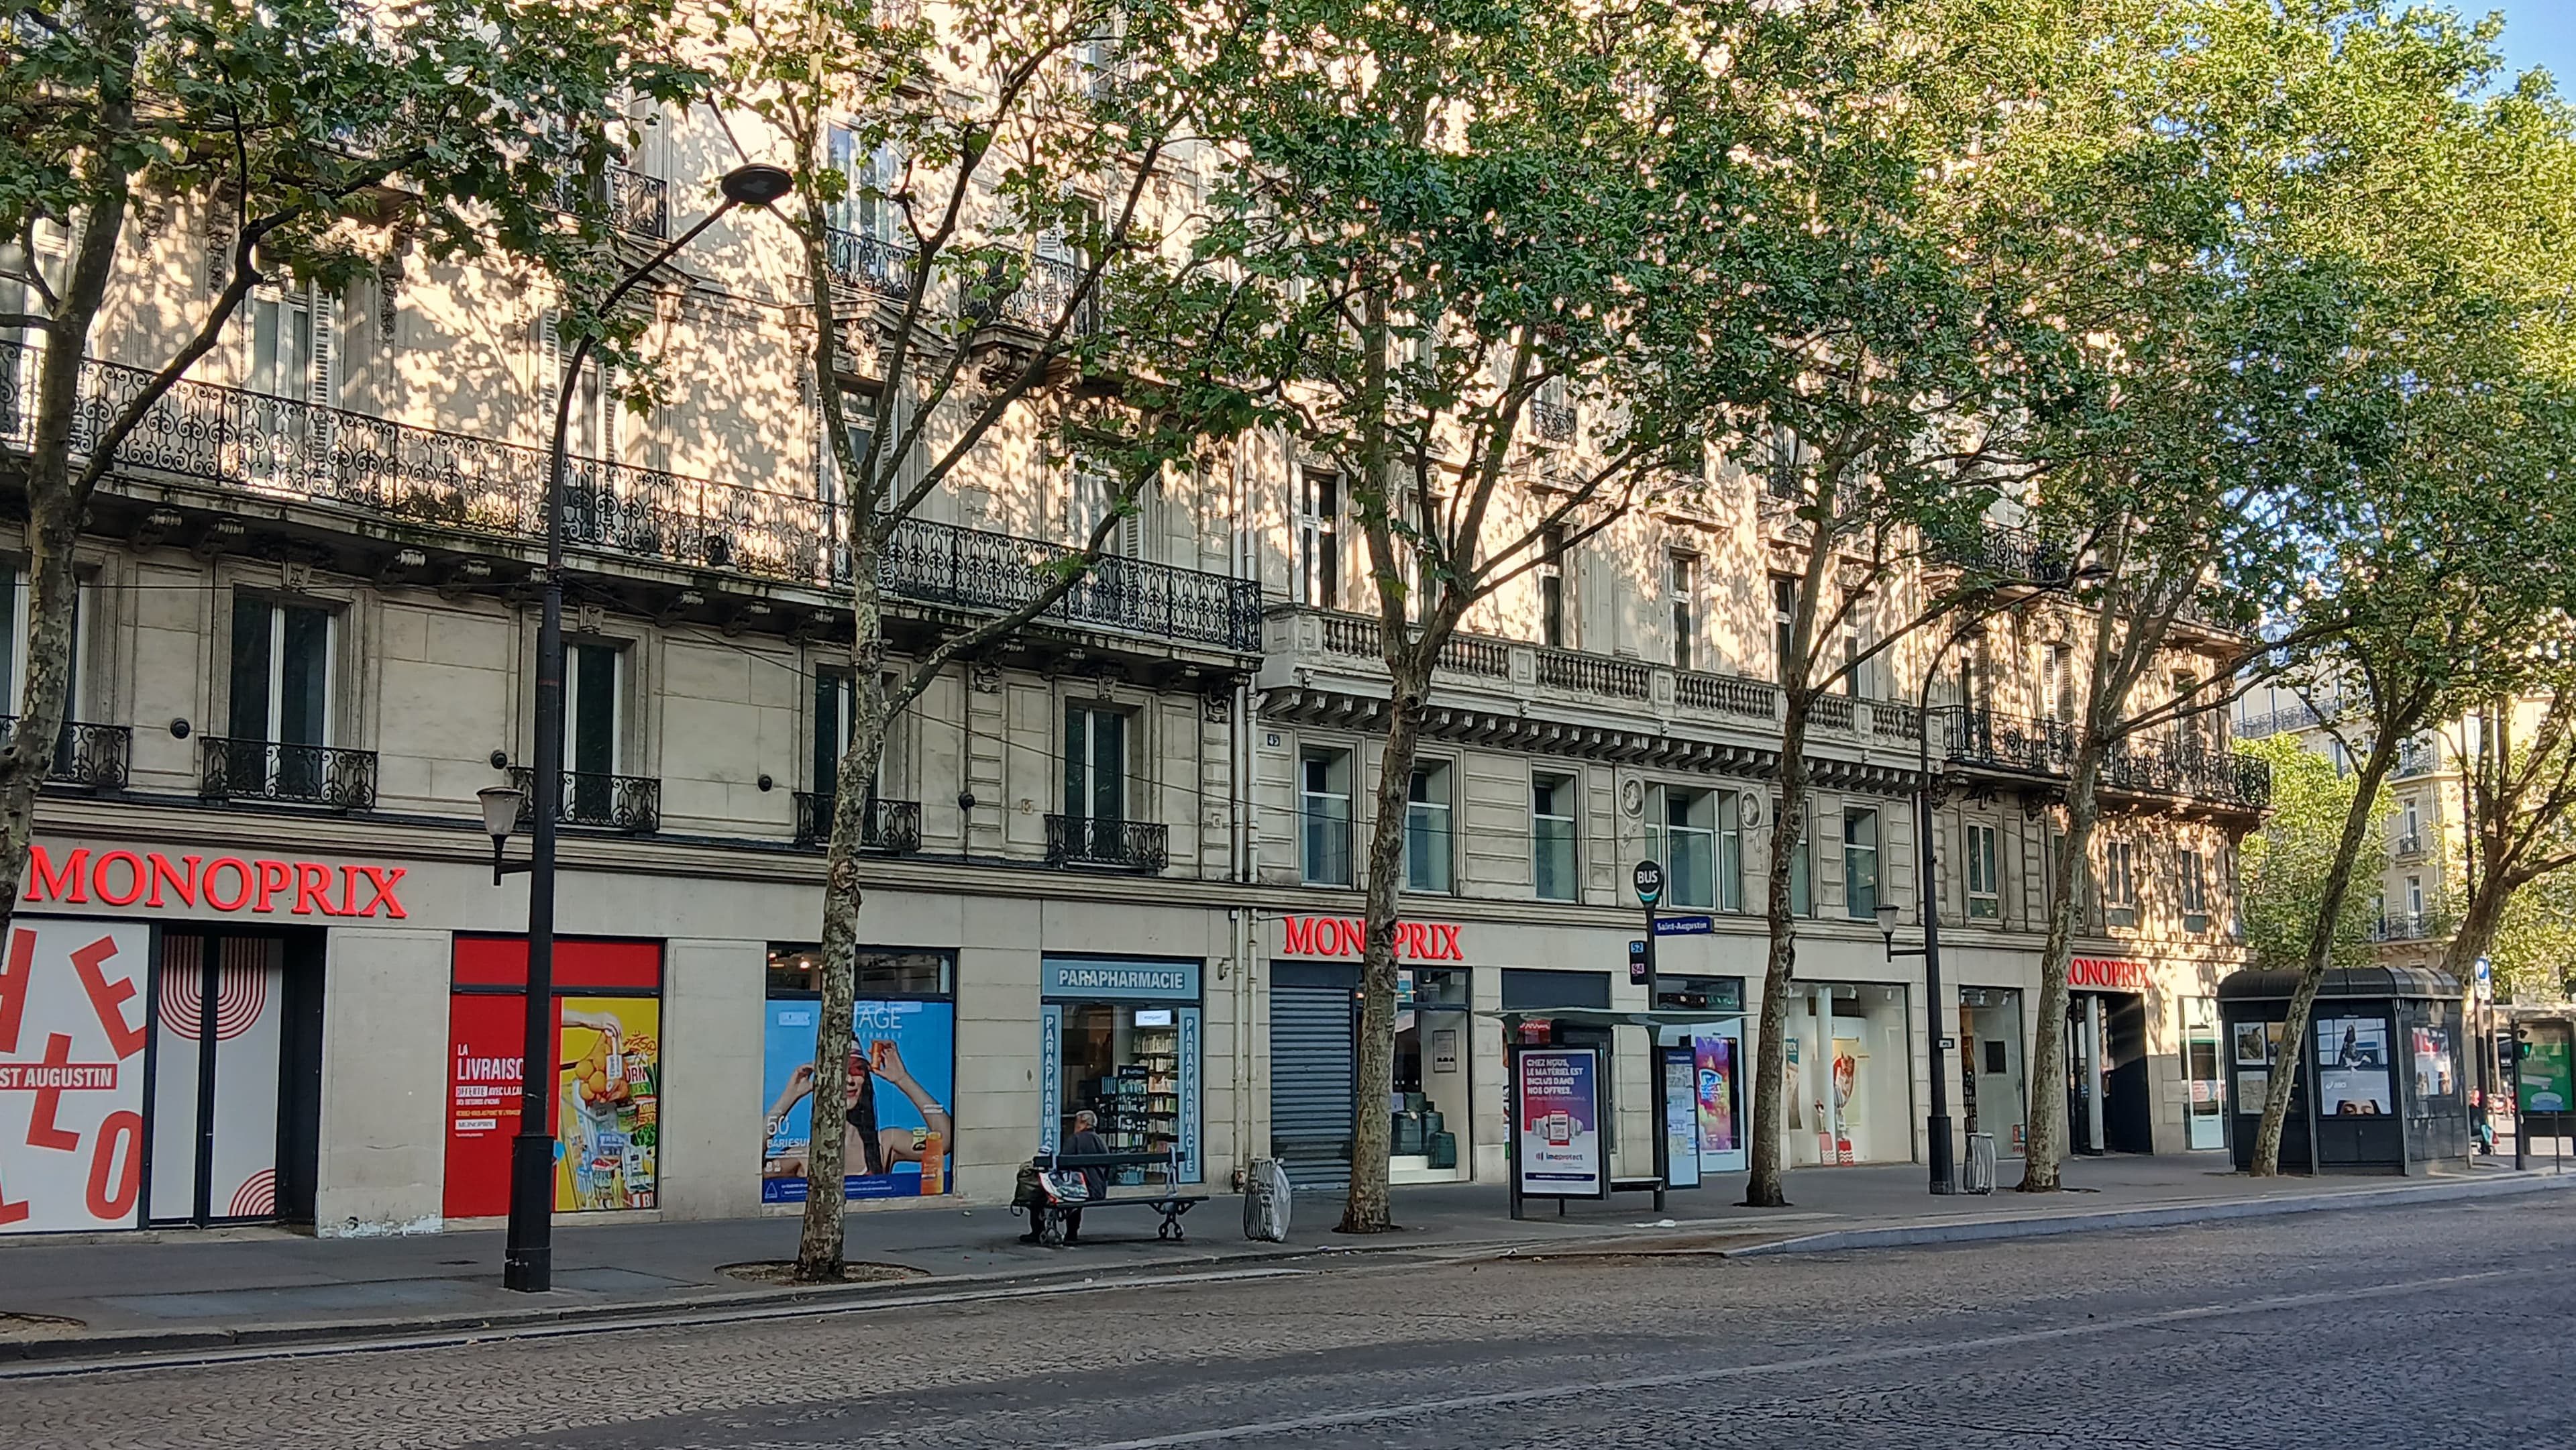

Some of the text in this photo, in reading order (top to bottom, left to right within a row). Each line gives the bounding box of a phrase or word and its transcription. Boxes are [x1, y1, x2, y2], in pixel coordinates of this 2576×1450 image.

[23, 845, 409, 919] MONOPRIX
[1637, 870, 1658, 884] BUS
[1657, 922, 1707, 931] Saint-Augustin
[1284, 916, 1464, 960] MONPRIX
[1632, 943, 1642, 951] 52
[1059, 968, 1184, 989] PARAPHARMACIE
[2068, 957, 2151, 988] ONOPRIX
[458, 1044, 468, 1055] LA
[457, 1058, 523, 1080] LIVRAISO
[1526, 1059, 1545, 1067] CHEZ
[0, 1068, 113, 1088] ST AUGUSTIN
[1554, 1077, 1574, 1085] DANS
[1185, 1019, 1195, 1174] PARAPHARMACIE
[1527, 1087, 1543, 1095] NOS
[767, 1115, 790, 1135] 50
